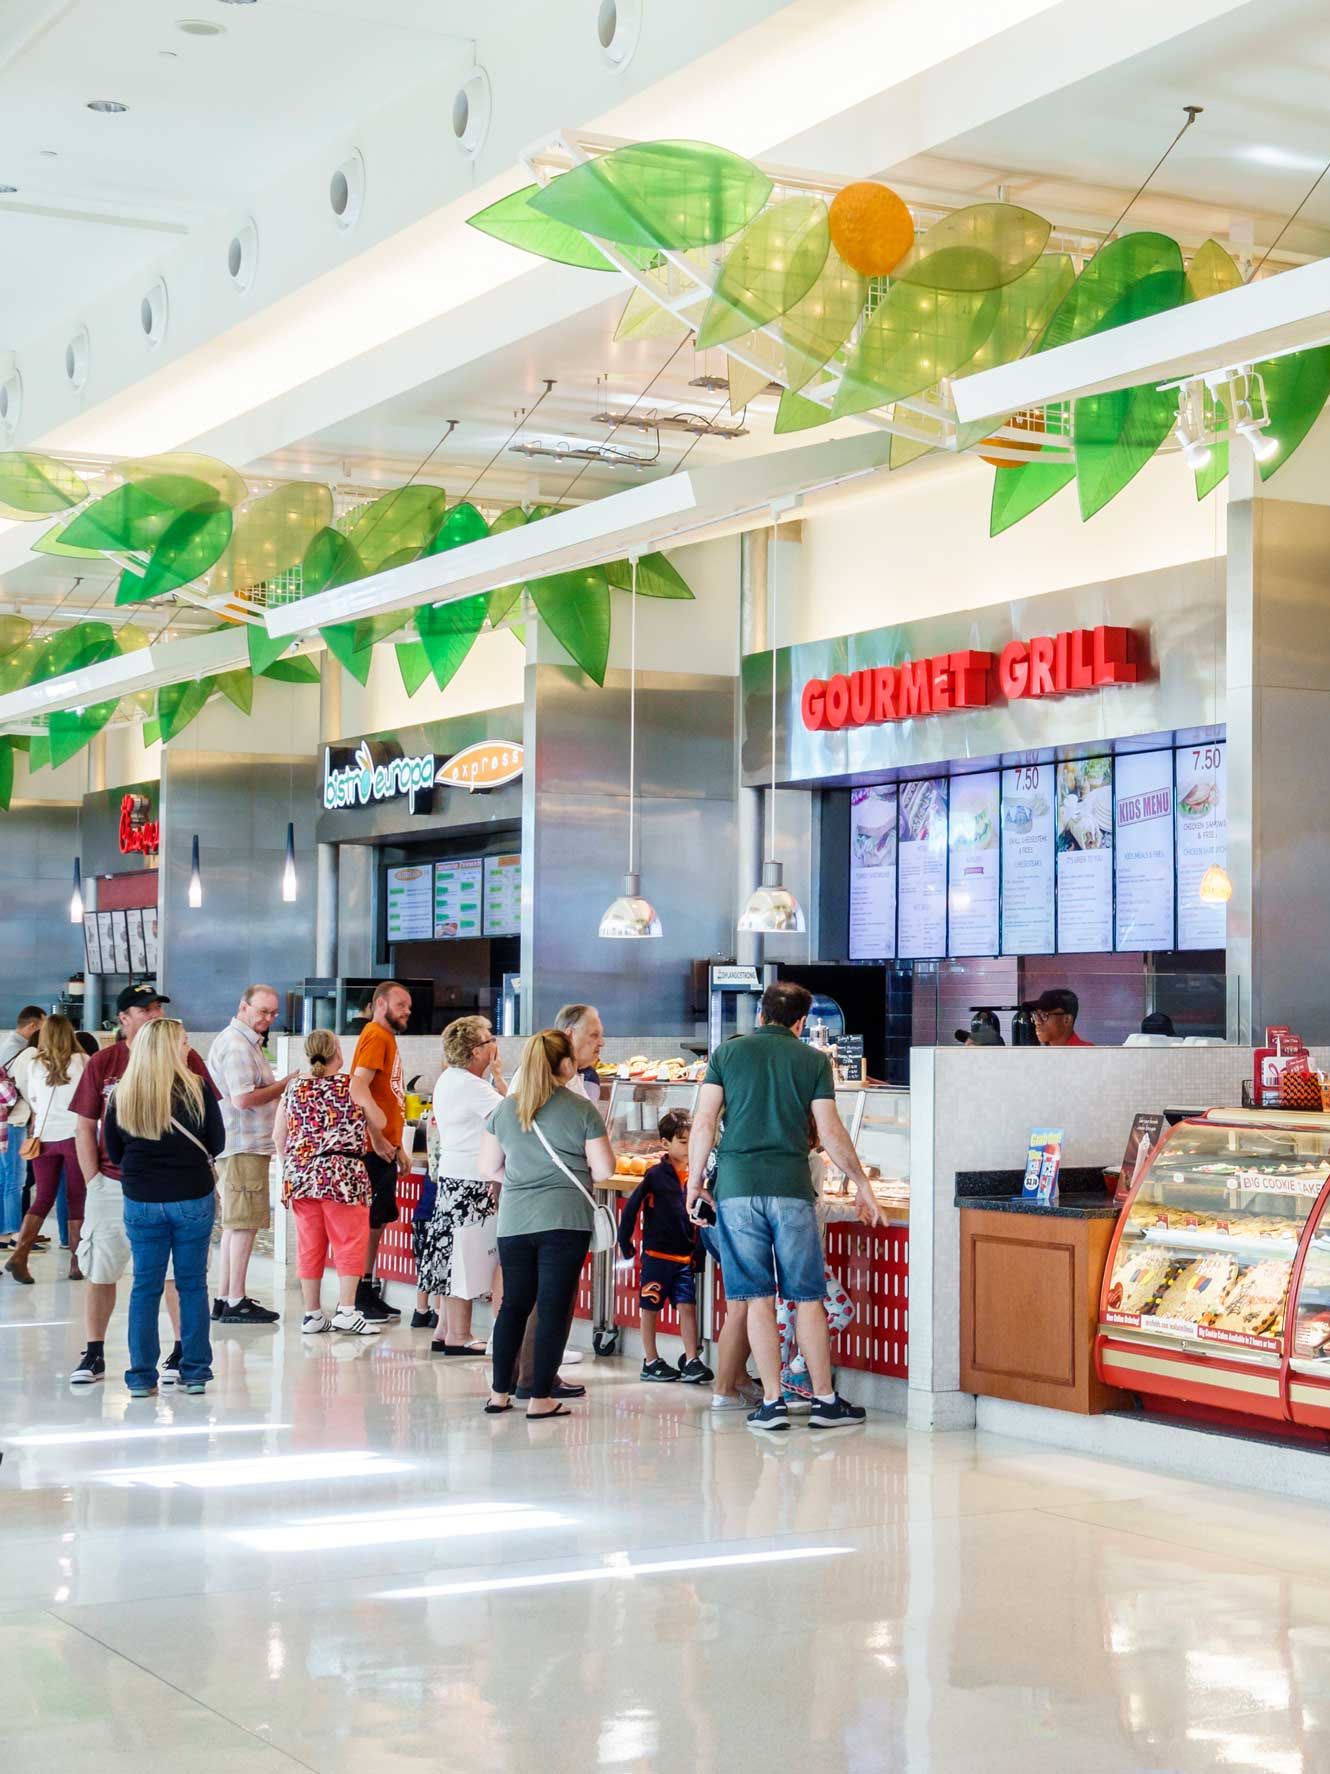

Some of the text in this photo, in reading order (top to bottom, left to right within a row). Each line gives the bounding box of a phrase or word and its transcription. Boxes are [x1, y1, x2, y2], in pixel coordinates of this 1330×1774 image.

[801, 625, 1136, 731] GOURMET GRILL
[452, 750, 519, 793] express
[1193, 748, 1220, 770] 7.50
[324, 742, 434, 815] bistro europa
[1014, 767, 1039, 791] 7.50
[1119, 791, 1169, 824] KIDS MENU
[1262, 1177, 1295, 1191] COOKIE
